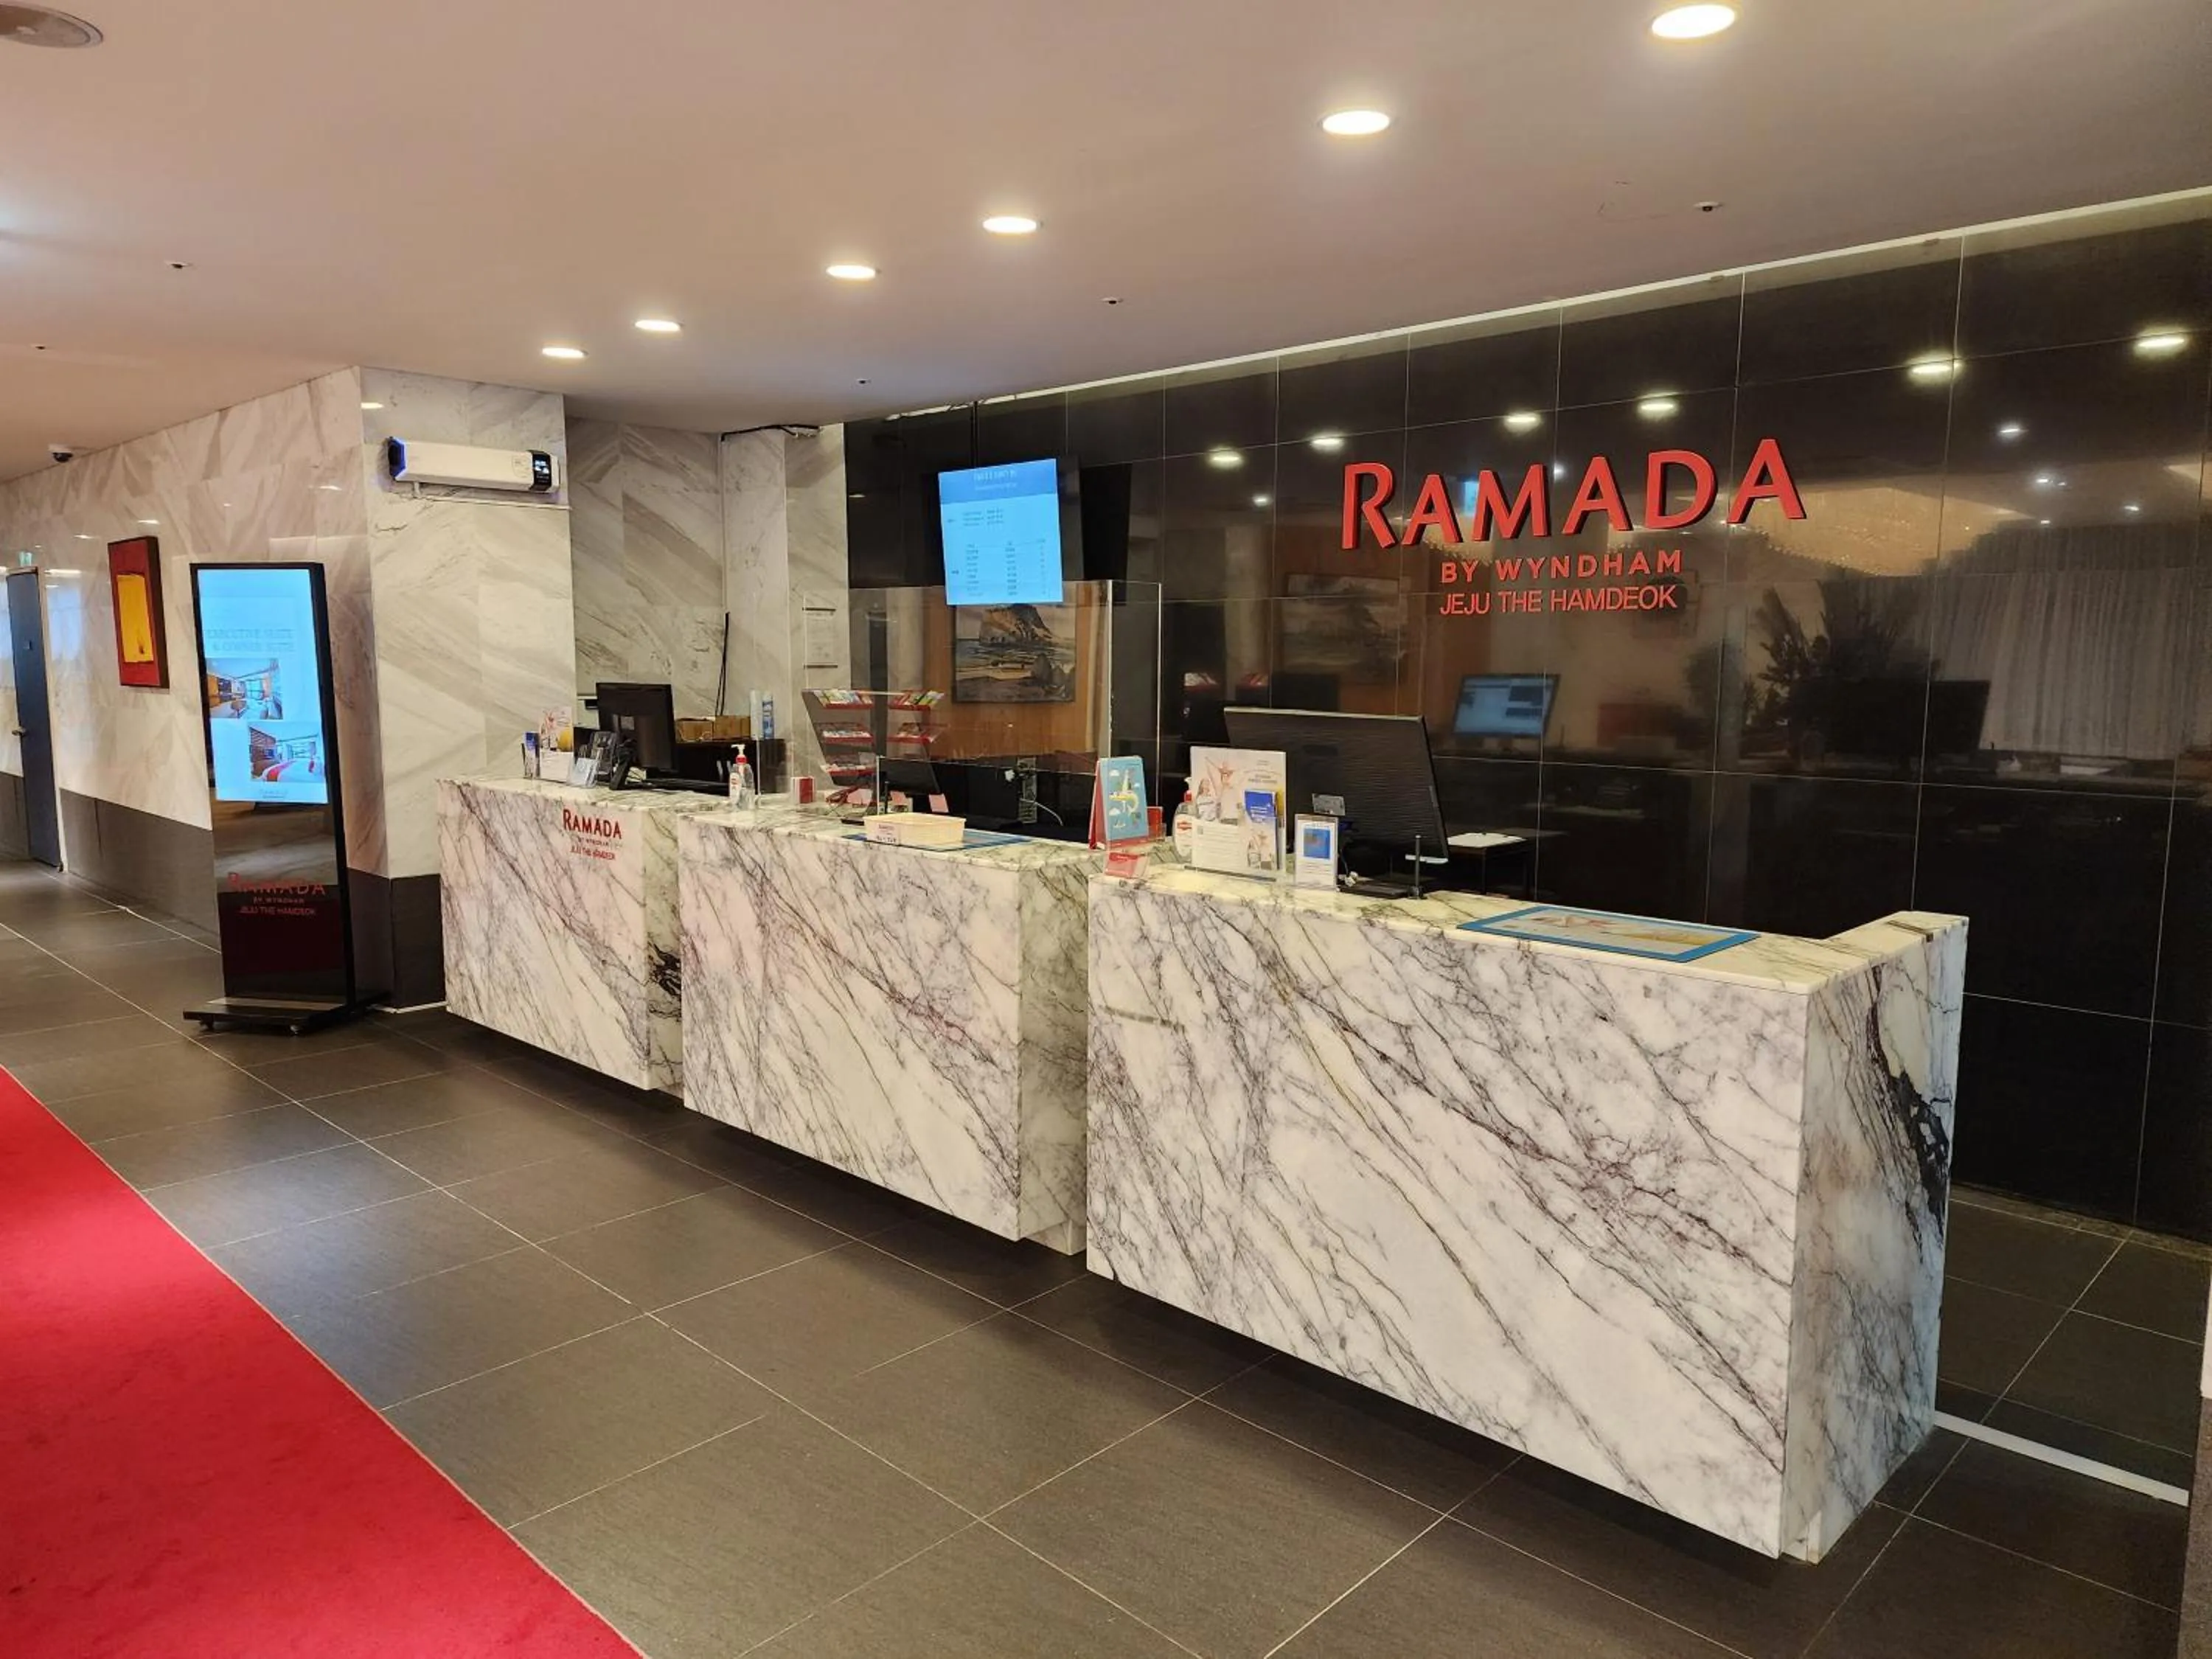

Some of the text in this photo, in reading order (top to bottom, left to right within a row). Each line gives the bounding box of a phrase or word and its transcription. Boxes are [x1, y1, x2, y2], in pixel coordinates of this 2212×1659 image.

[1341, 438, 1808, 550] RAMADA
[1441, 549, 1683, 584] BY WYNDHAM
[1439, 583, 1679, 615] JEJU THE HAMDEOK
[563, 808, 622, 840] RAMADA
